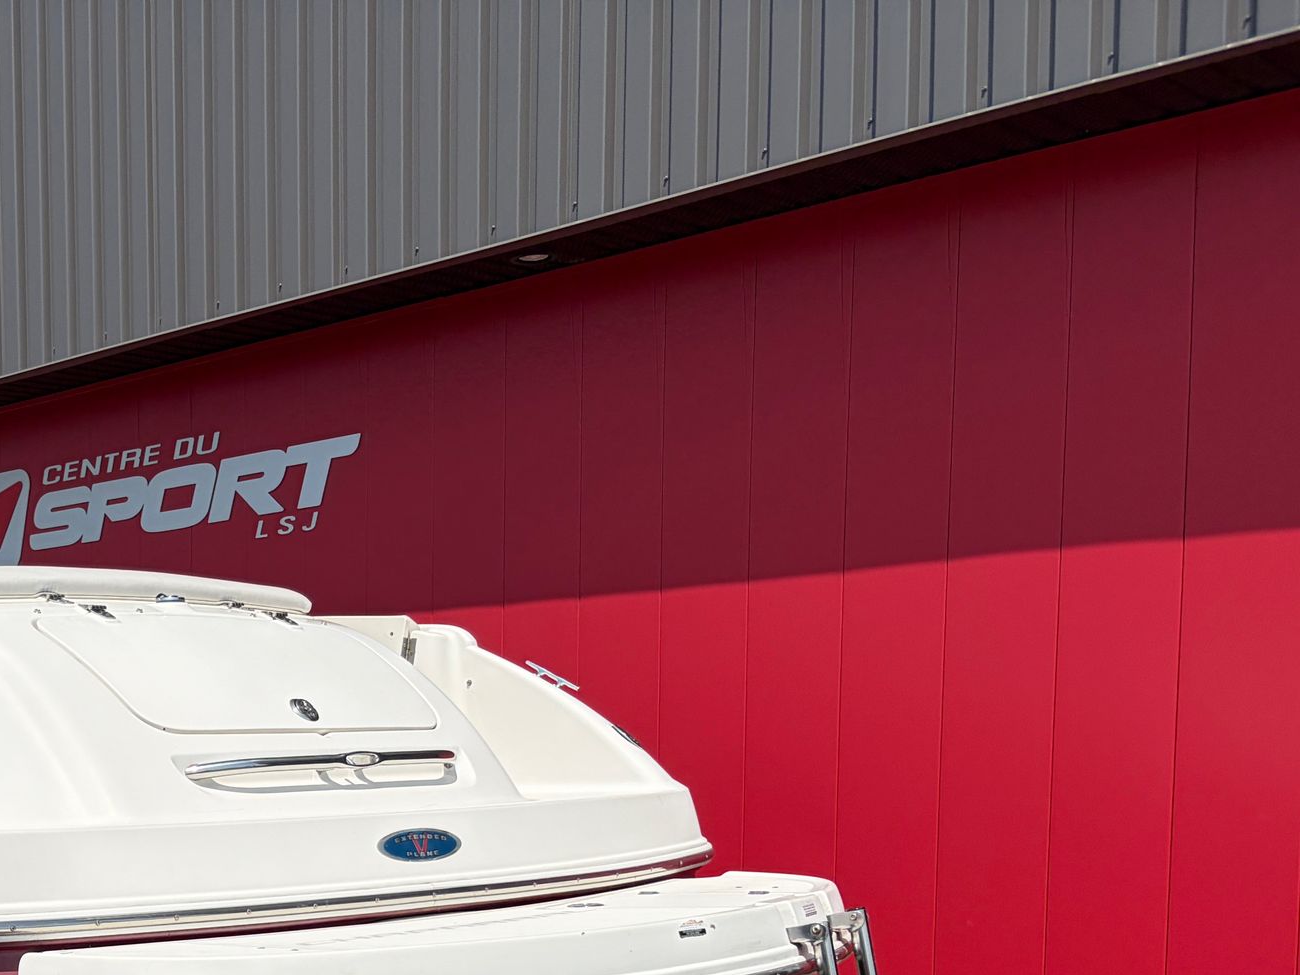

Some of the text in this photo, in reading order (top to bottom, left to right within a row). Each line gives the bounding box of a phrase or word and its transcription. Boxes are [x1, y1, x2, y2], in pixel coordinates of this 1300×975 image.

[42, 431, 221, 485] CENTRE DU
[29, 433, 361, 551] SPORT
[394, 833, 447, 843] EXTENDED
